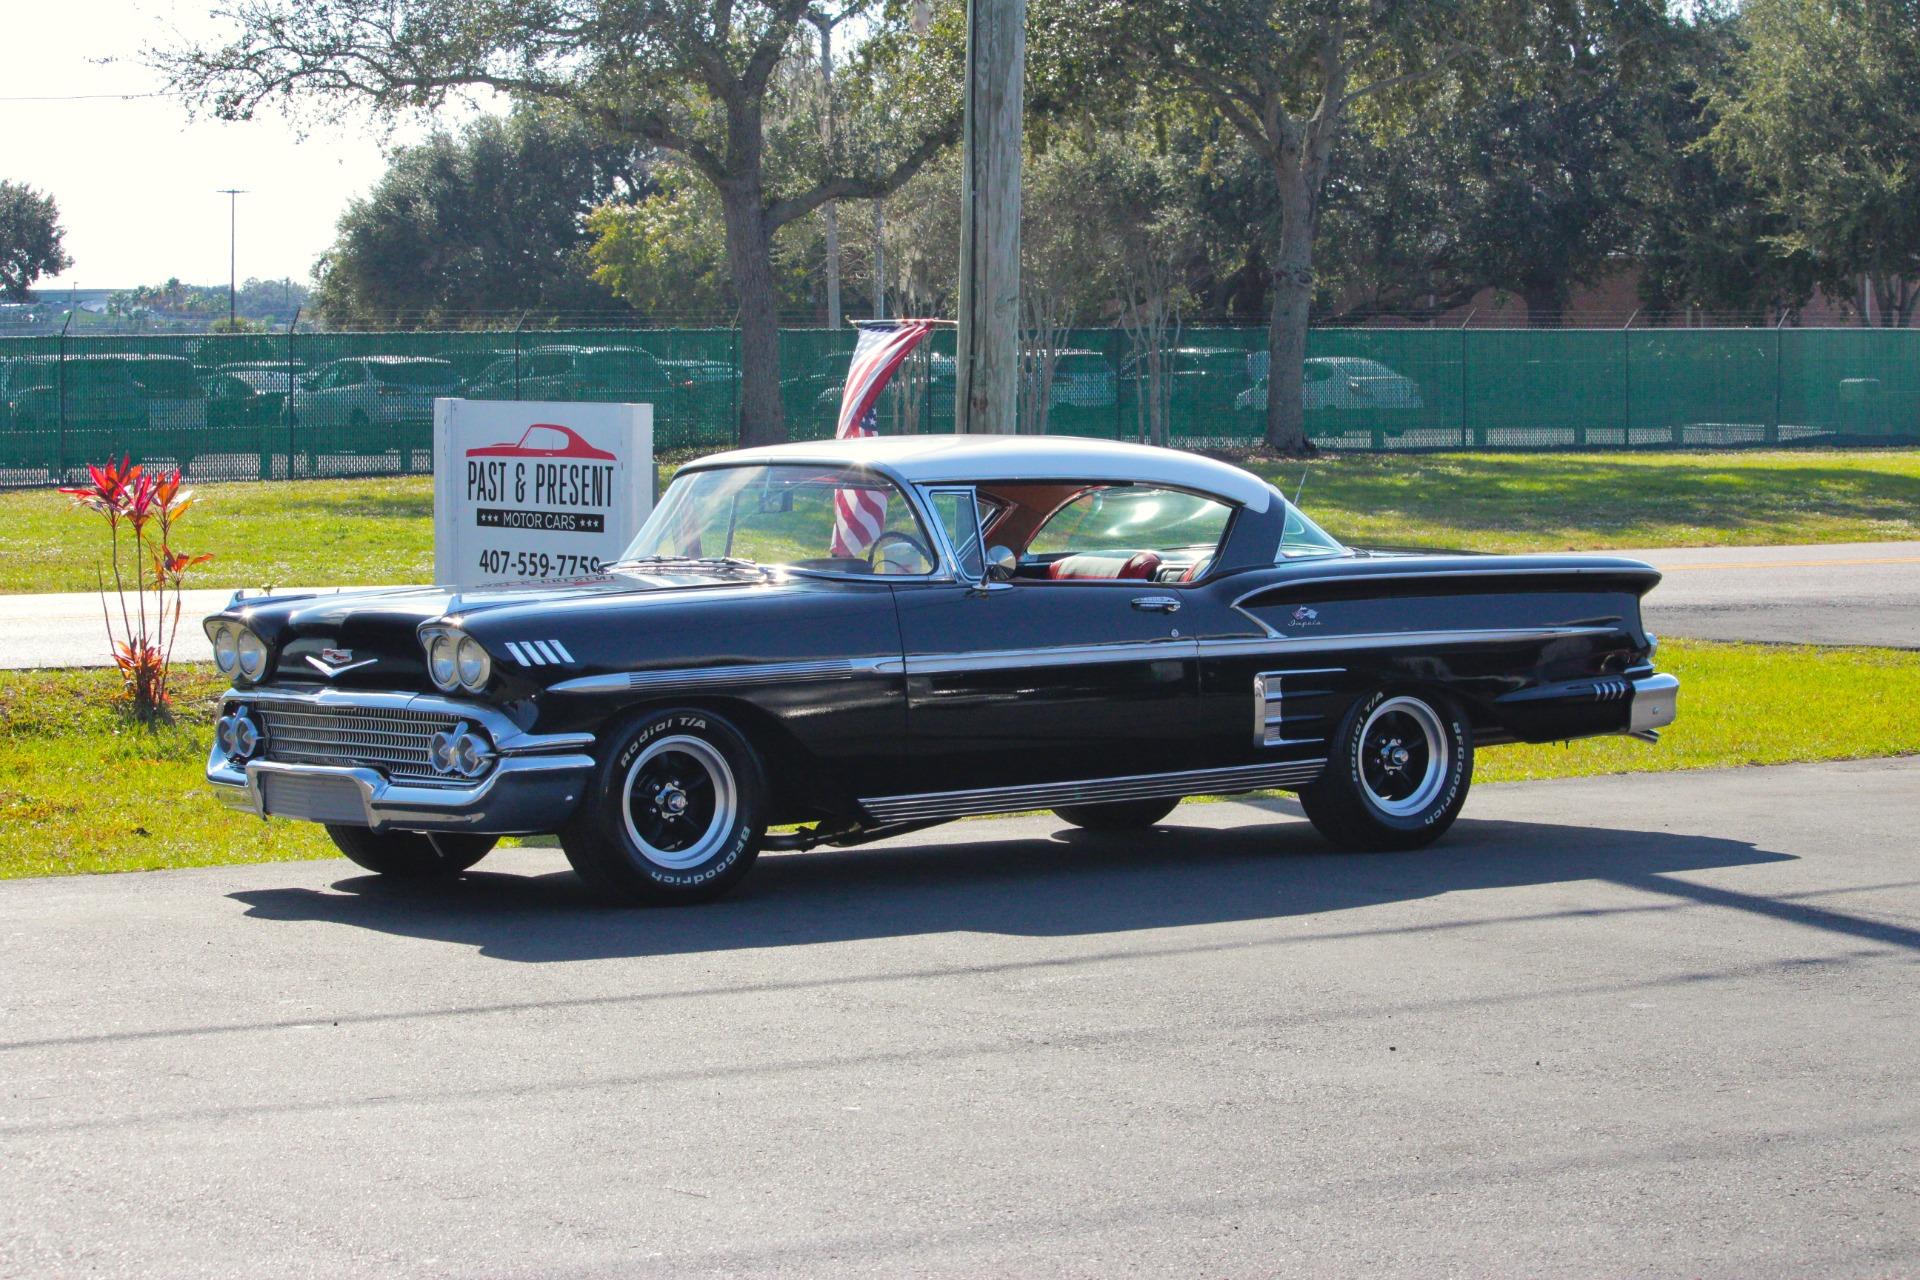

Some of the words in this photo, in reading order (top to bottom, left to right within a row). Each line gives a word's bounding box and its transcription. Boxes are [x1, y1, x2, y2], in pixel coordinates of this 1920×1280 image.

[467, 460, 507, 502] PAST
[515, 462, 527, 503] &
[535, 463, 614, 508] PRESENT
[503, 512, 542, 528] MOTOR
[544, 514, 576, 530] CARS
[621, 718, 673, 769] Radial
[679, 717, 708, 730] T/A
